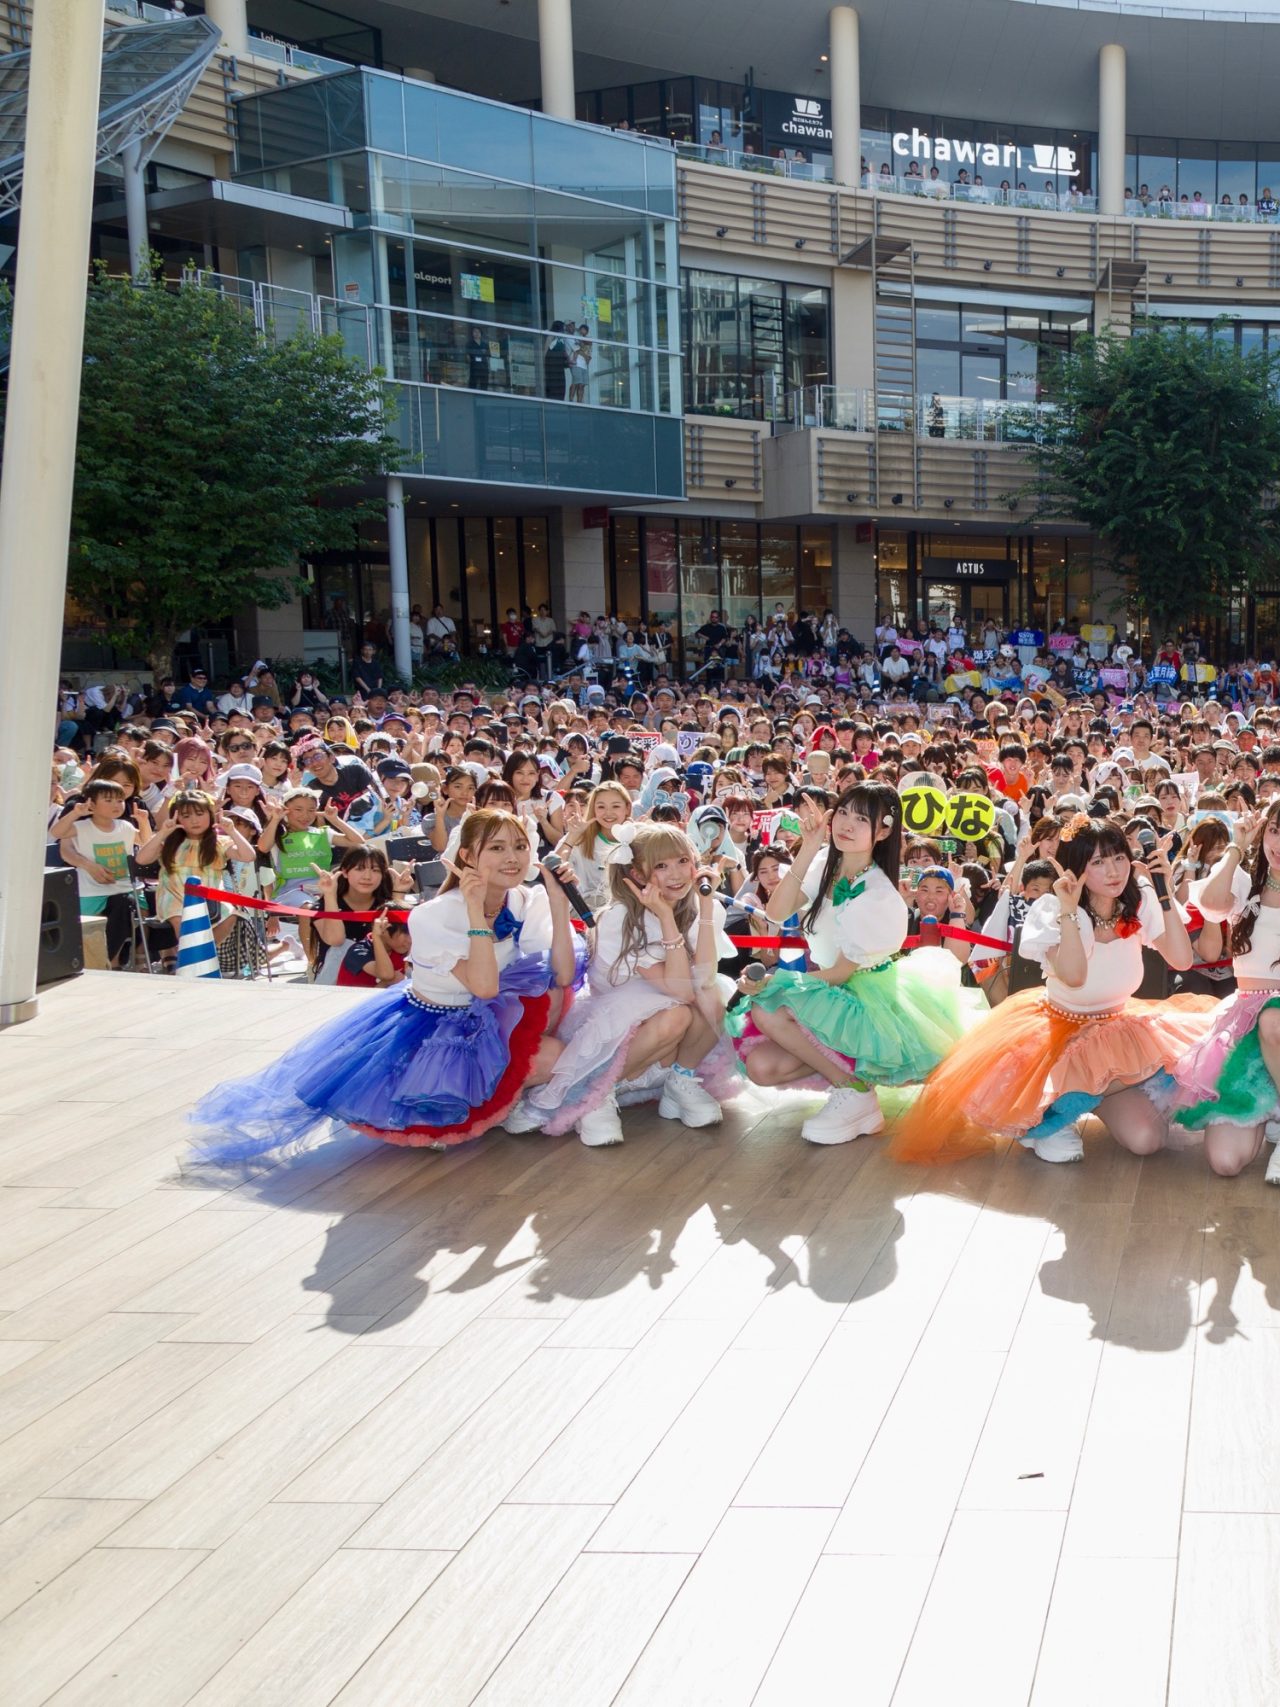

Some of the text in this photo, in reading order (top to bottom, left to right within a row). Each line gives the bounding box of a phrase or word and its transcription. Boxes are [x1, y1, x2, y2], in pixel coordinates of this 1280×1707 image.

[782, 121, 832, 139] chawan
[892, 127, 1022, 169] chawan
[414, 272, 452, 285] aLaport
[956, 562, 985, 575] ACTUS
[902, 792, 990, 836] ひな
